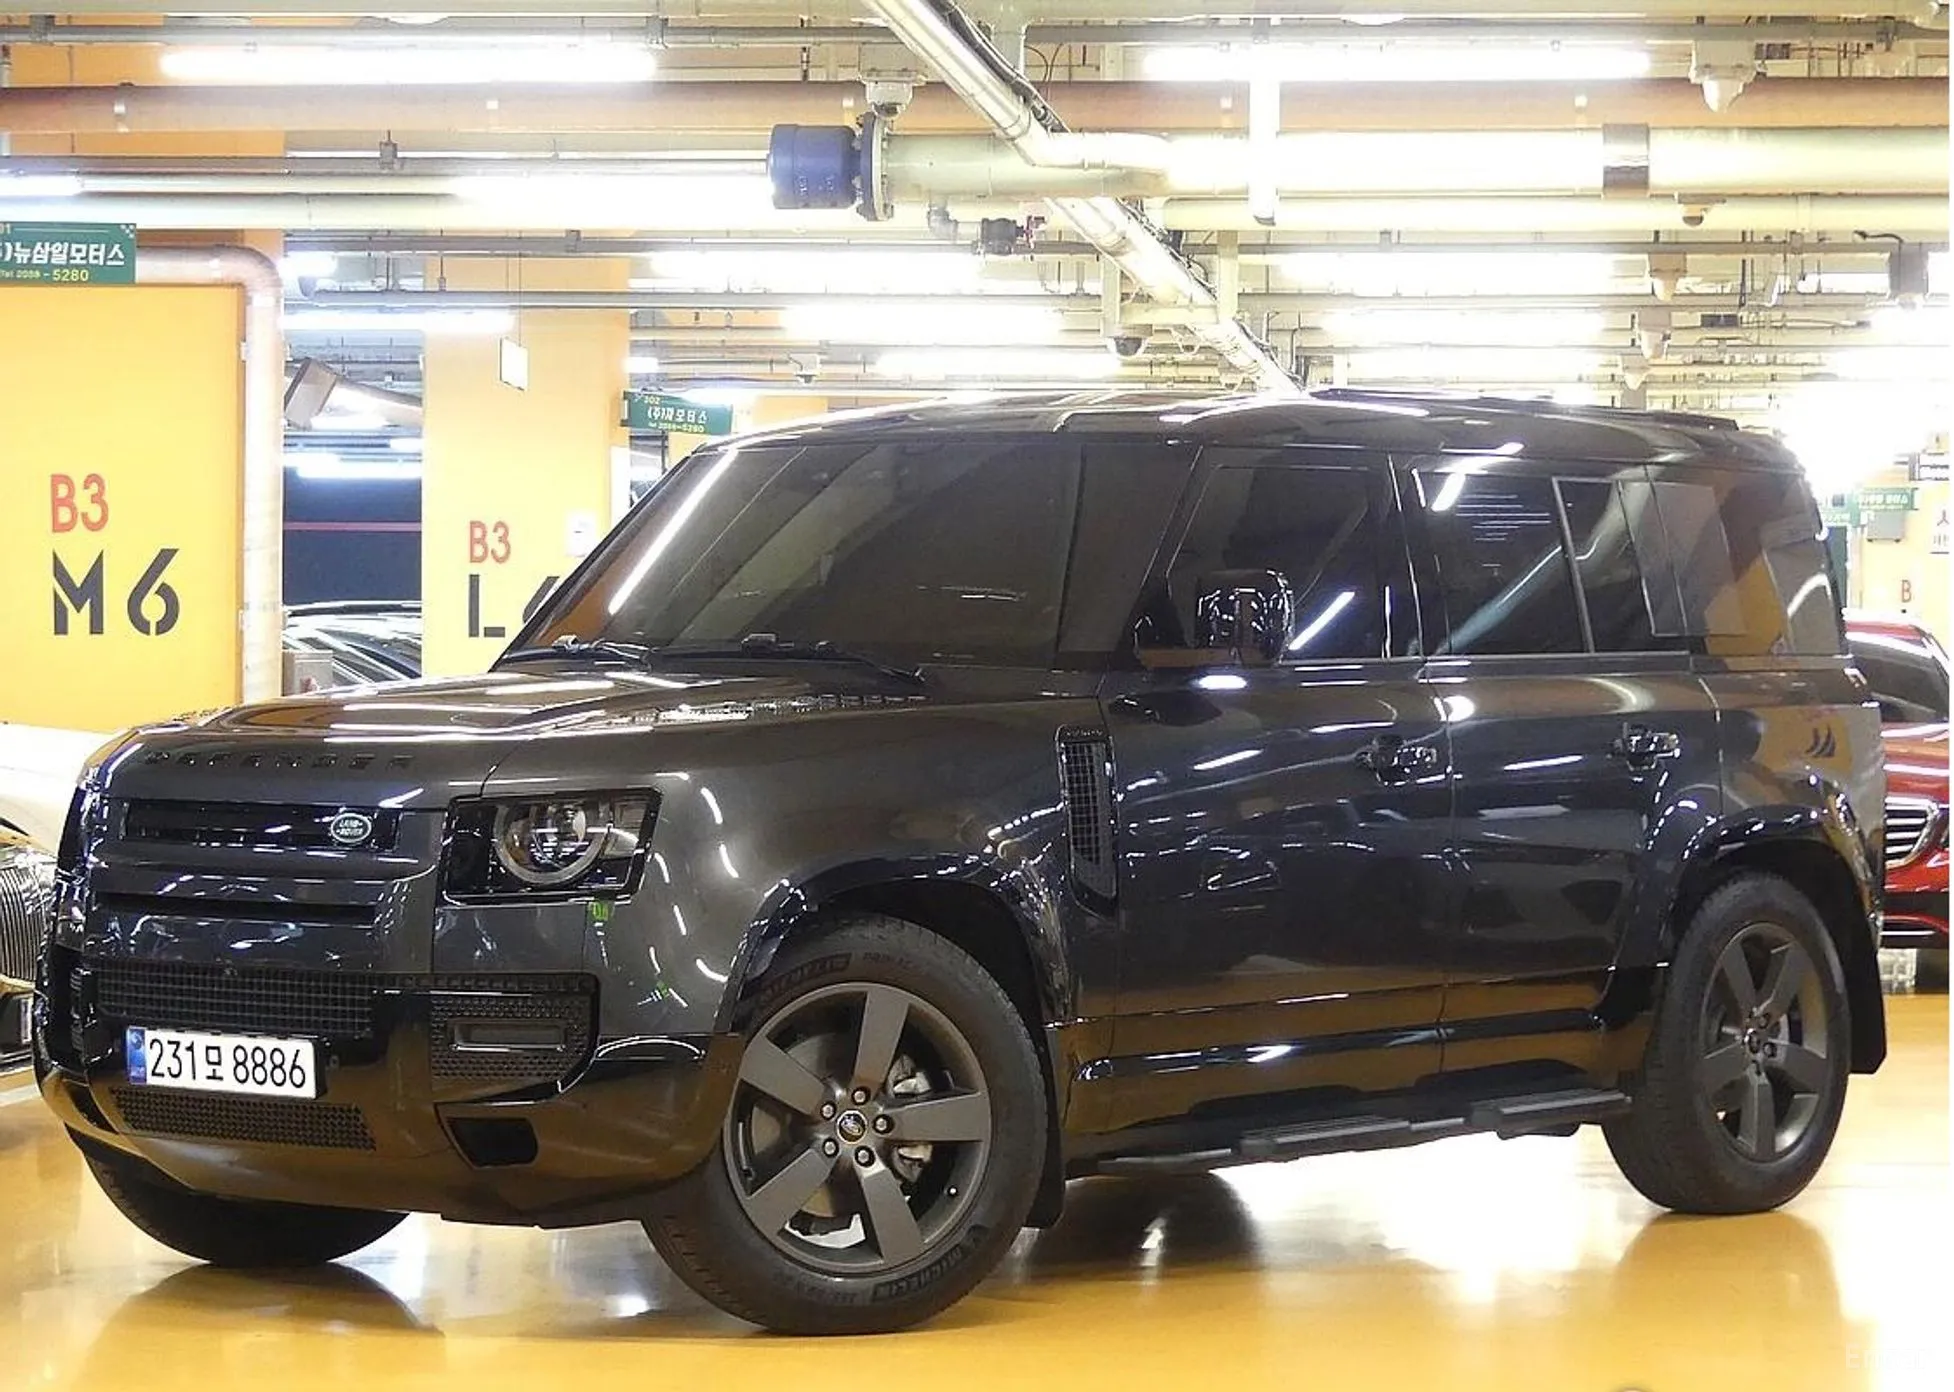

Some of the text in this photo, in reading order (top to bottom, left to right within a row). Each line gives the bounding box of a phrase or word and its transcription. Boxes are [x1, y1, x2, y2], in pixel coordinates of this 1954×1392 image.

[0, 241, 125, 266] )뉴삼일모터스
[51, 474, 109, 533] B3
[469, 520, 511, 564] B3
